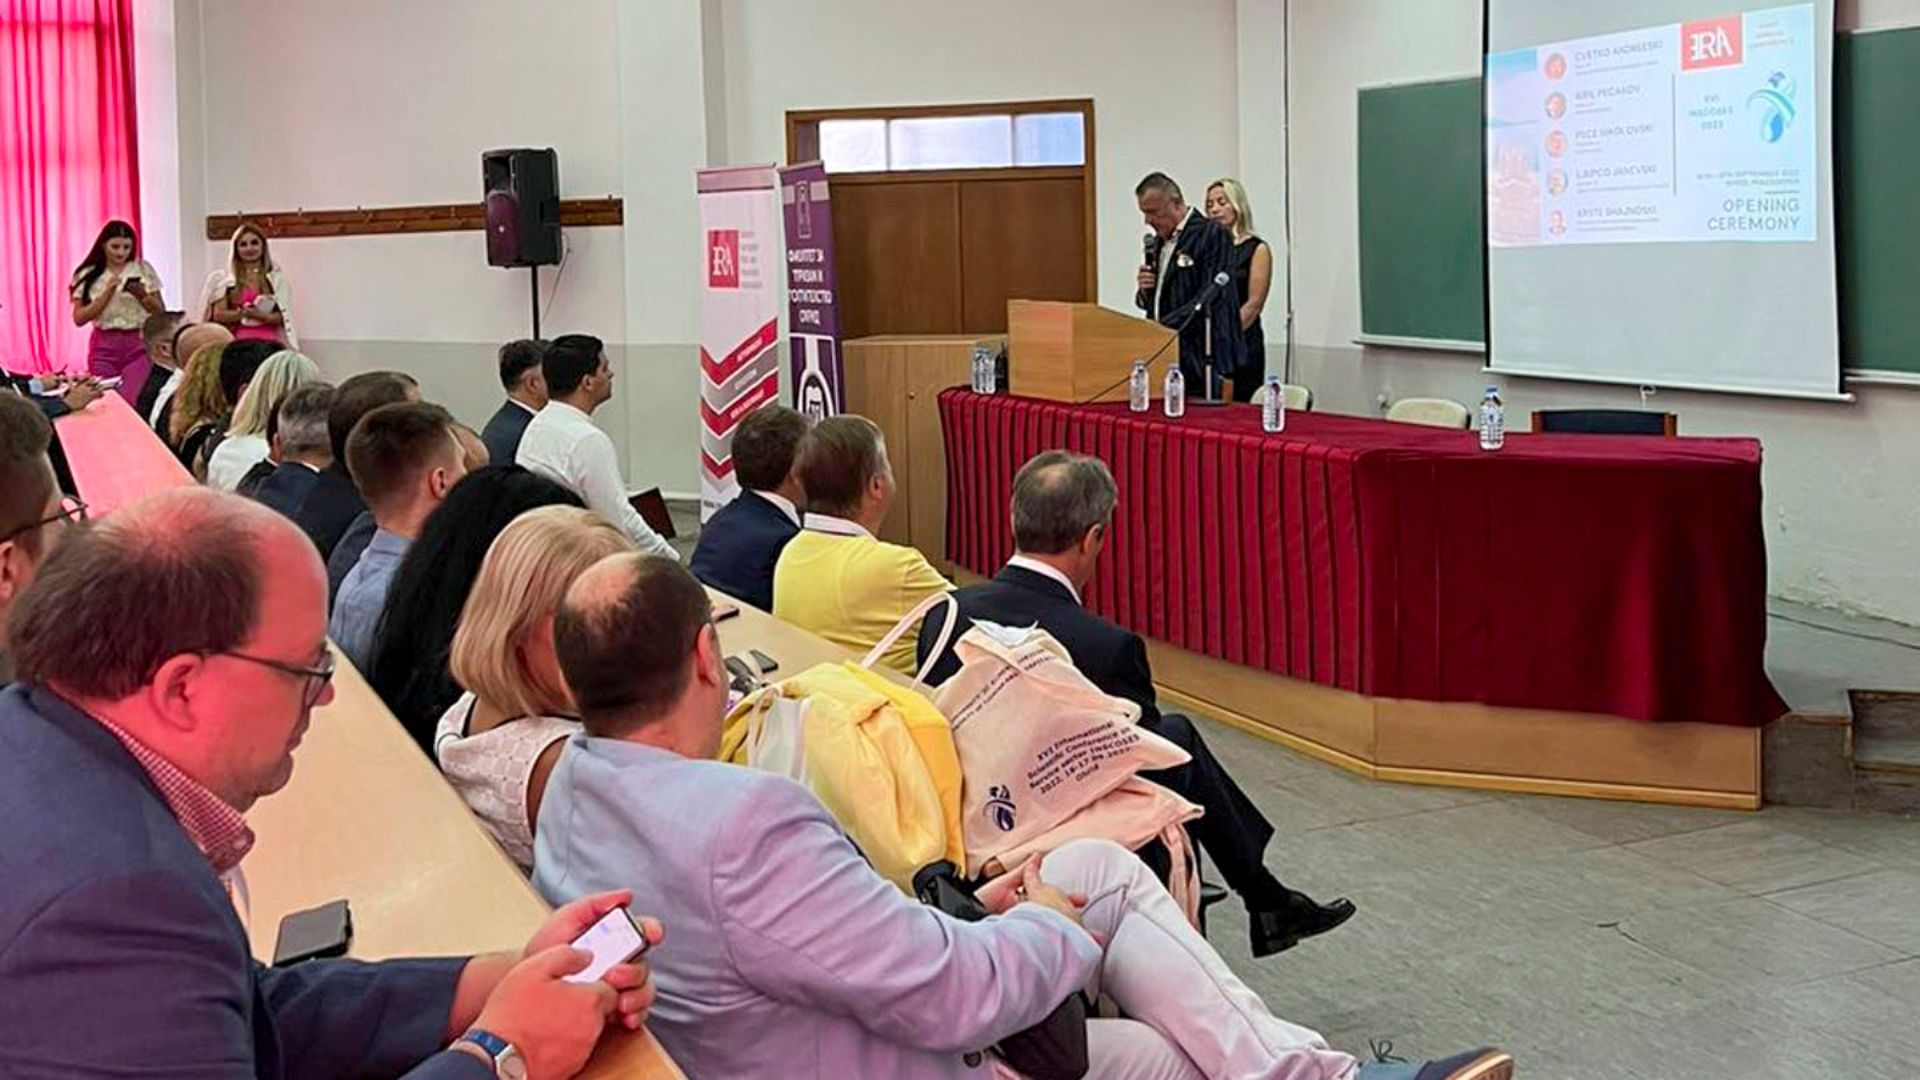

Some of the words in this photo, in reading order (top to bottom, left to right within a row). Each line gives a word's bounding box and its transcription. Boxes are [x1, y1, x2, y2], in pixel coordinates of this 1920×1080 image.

[1722, 197, 1800, 213] OPENING
[1706, 215, 1800, 231] CEREMONY
[1065, 731, 1119, 754] Conference
